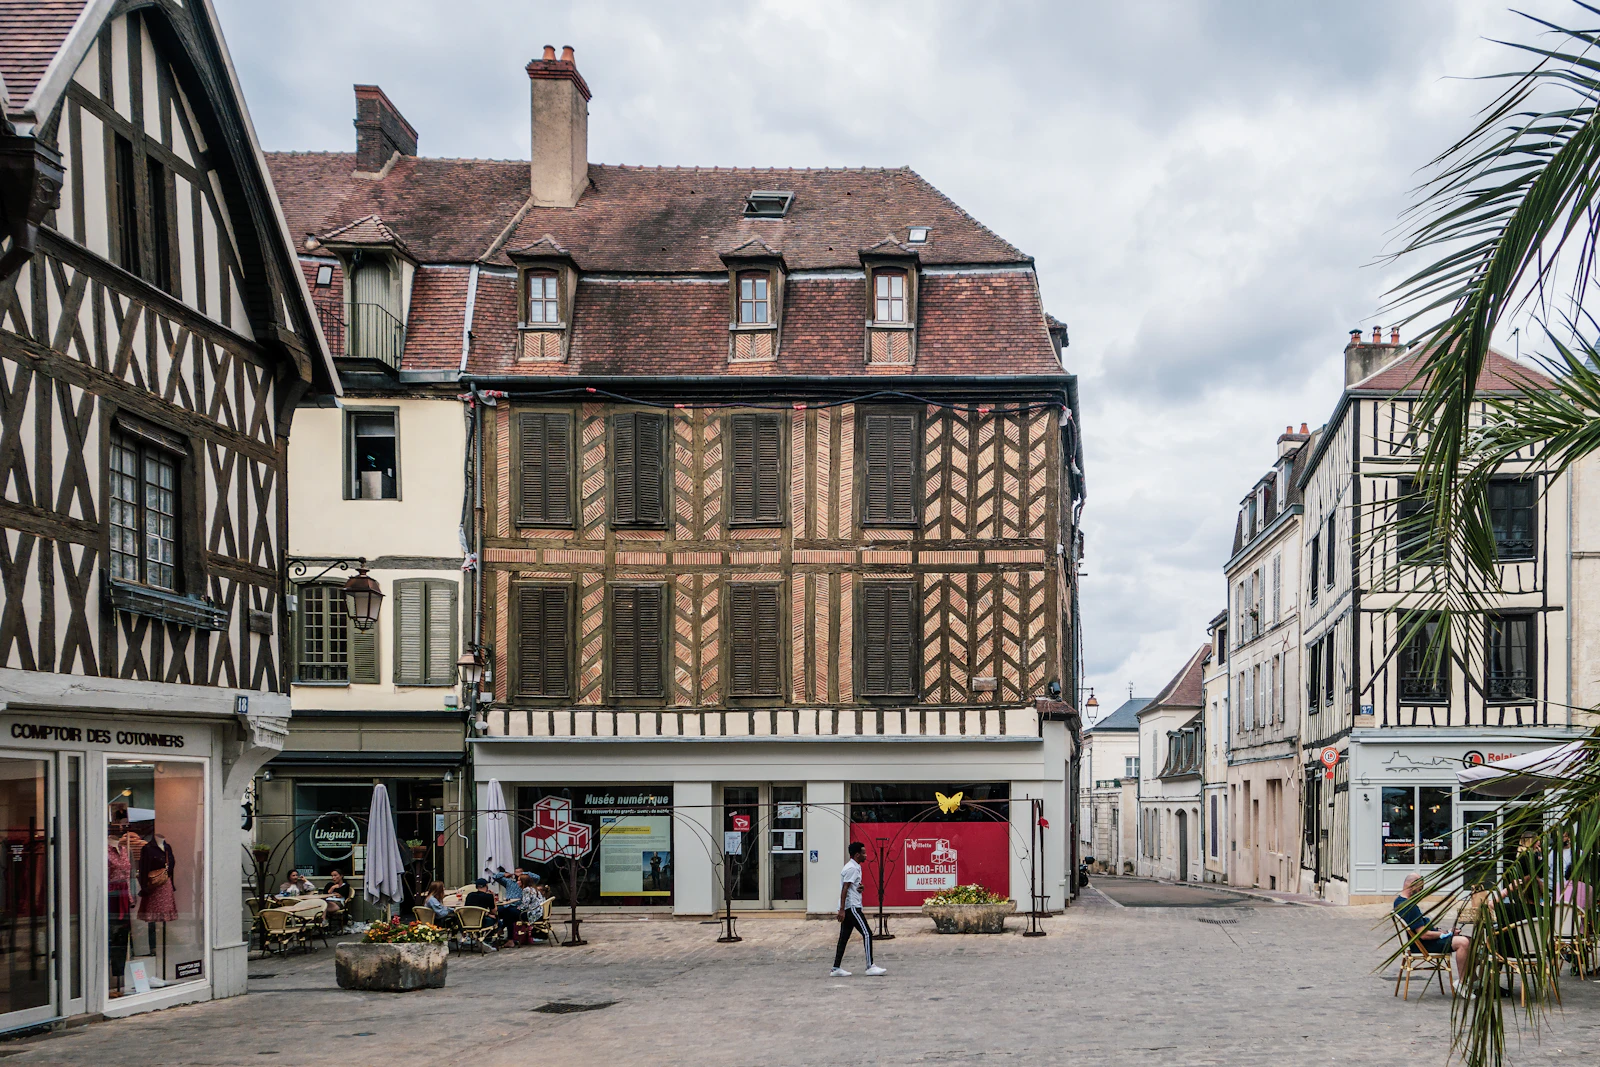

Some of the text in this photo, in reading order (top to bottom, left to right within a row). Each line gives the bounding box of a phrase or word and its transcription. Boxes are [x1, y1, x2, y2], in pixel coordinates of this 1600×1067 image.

[237, 697, 247, 712] 18
[1361, 705, 1372, 714] 27
[11, 723, 185, 748] COMPTOIR DES COTONNIERS
[584, 793, 669, 806] Musée numérique
[315, 829, 355, 841] Linguini
[906, 864, 956, 874] MICRO-FOLIE
[916, 877, 946, 886] AUXERRE
